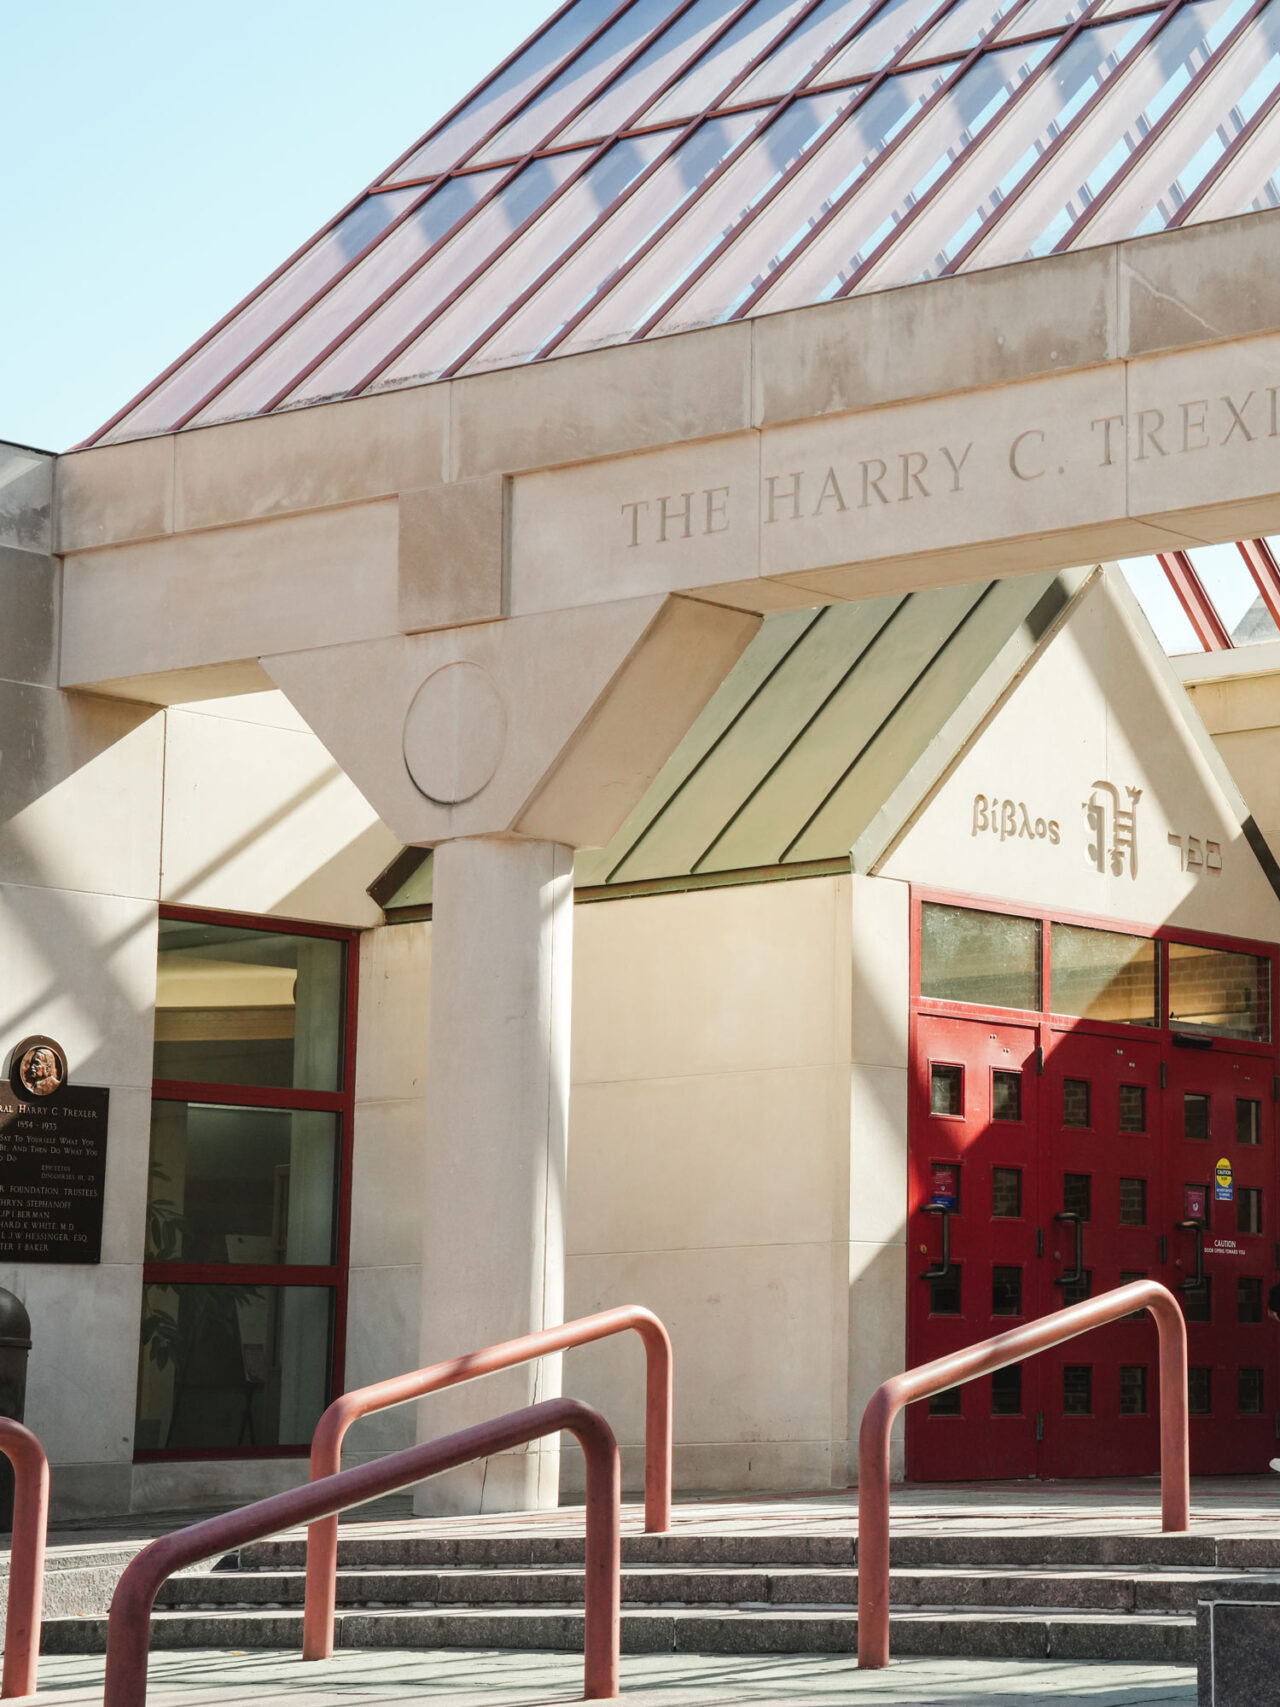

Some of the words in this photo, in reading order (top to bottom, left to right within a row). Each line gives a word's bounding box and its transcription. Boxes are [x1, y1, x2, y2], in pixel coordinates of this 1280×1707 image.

[621, 486, 730, 548] THE
[764, 442, 973, 524] HARRY
[1008, 429, 1066, 481] C.
[19, 1104, 48, 1115] HARRY
[62, 1107, 98, 1118] TREXLER
[9, 1185, 59, 1195] FOUNDATION
[63, 1188, 98, 1197] TRUSTEES
[17, 1210, 50, 1218] BERMAN
[1214, 1240, 1236, 1248] CAUTION
